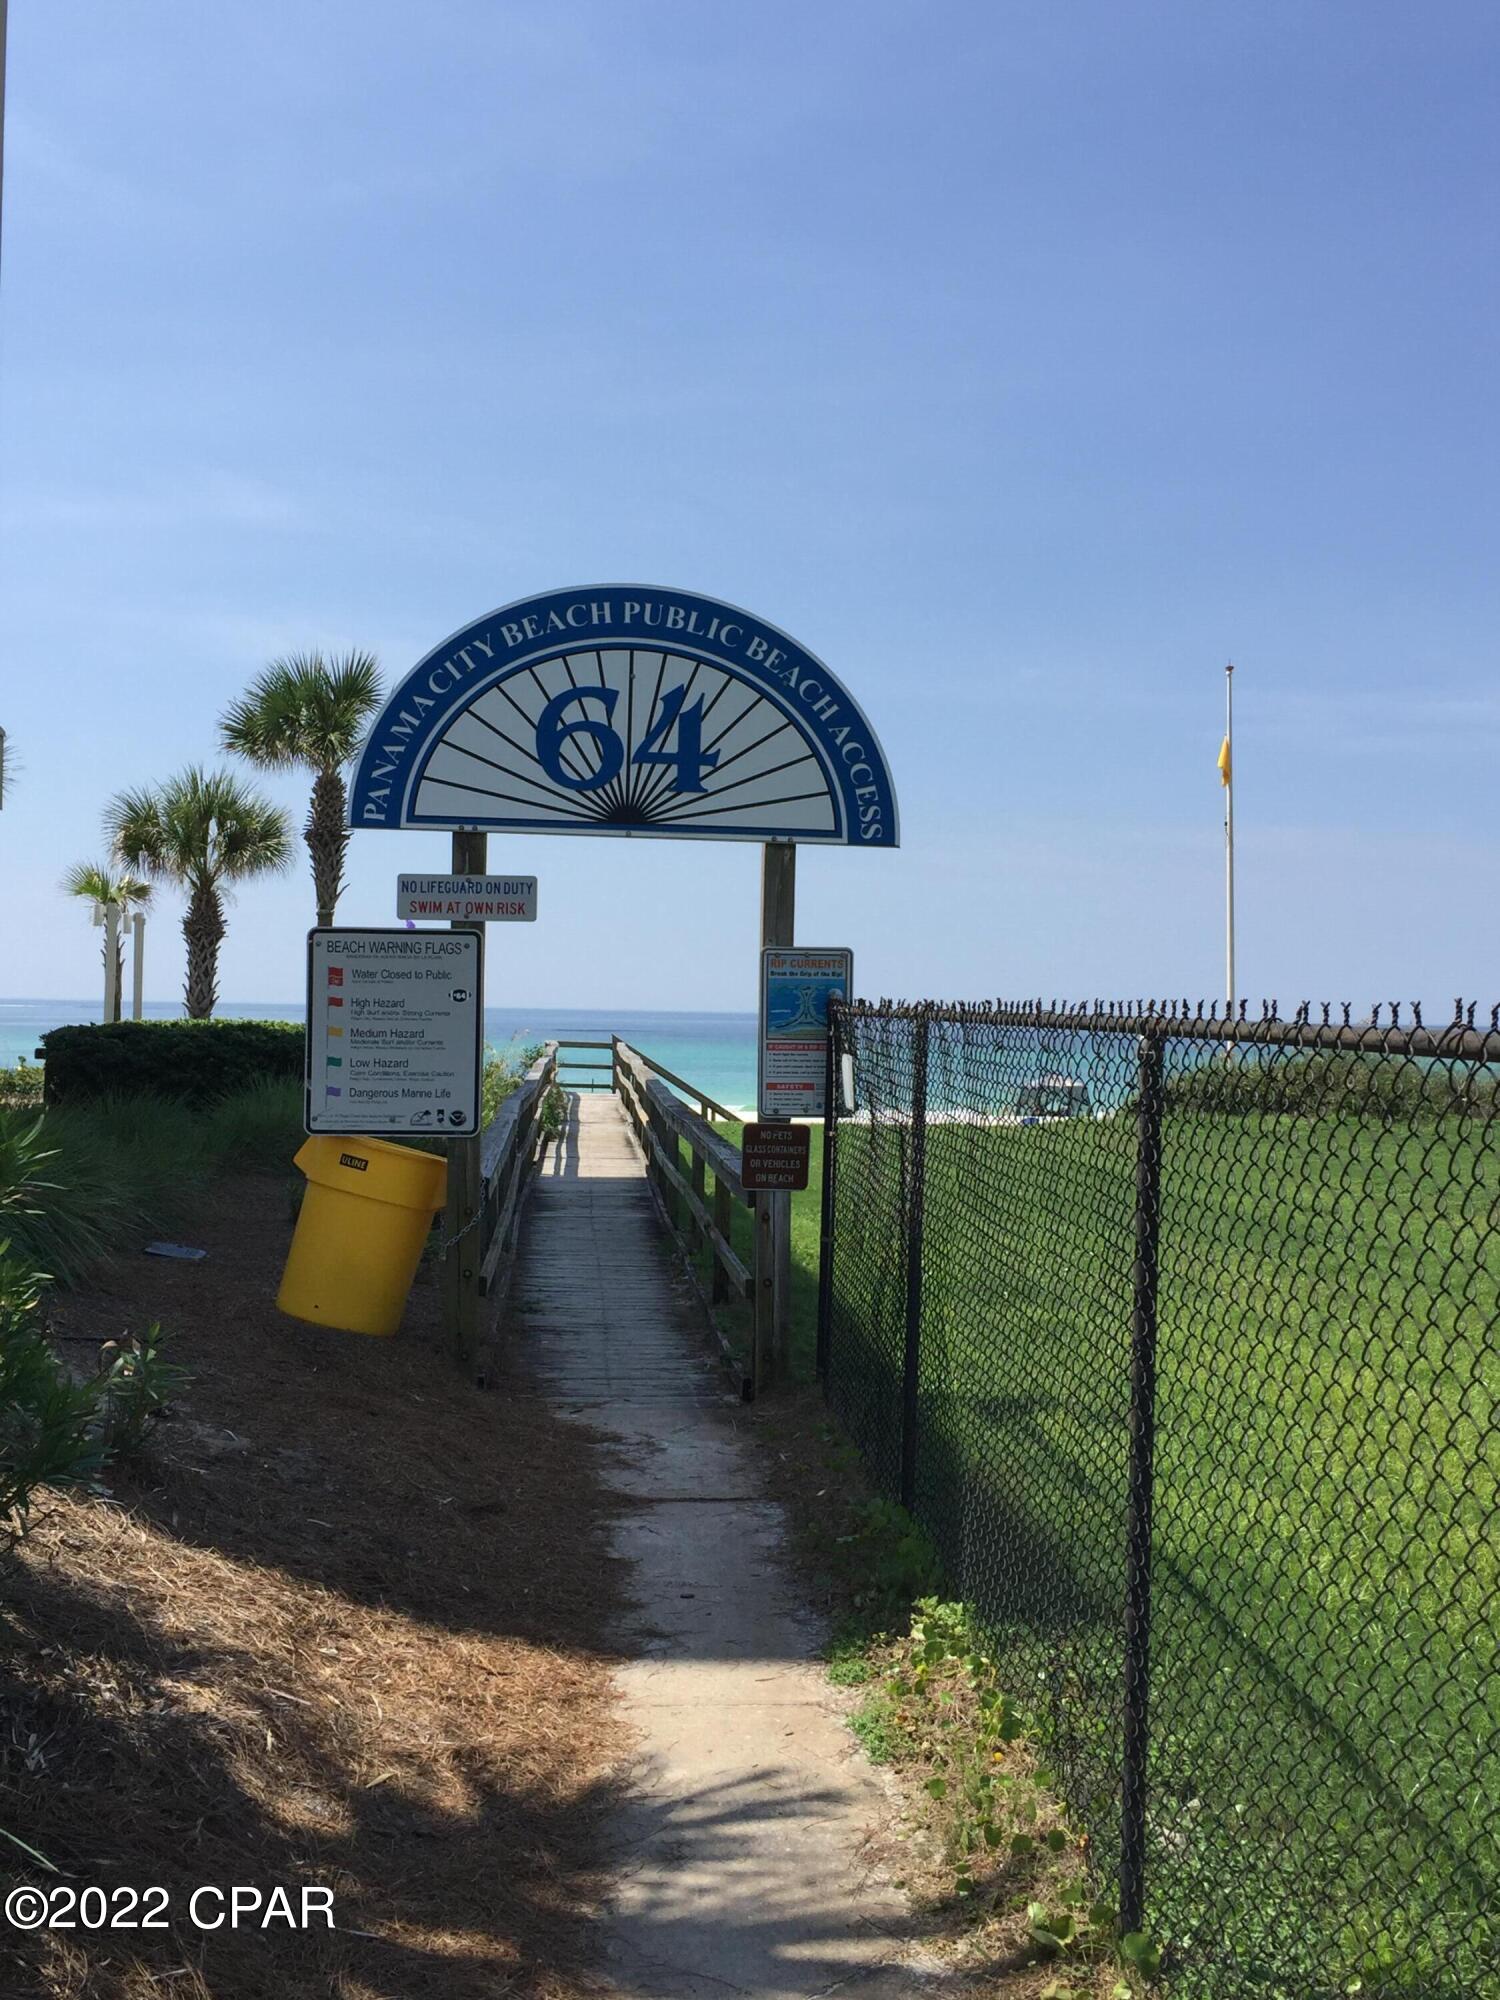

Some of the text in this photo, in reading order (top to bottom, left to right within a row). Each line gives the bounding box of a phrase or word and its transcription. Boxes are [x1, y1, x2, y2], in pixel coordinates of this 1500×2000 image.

[364, 601, 884, 841] PANAMA CITY BEACH PUBLIC BEACH ACCESS
[535, 683, 721, 792] 64
[401, 880, 533, 894] NO LIFEGUARD ON DUTY
[410, 900, 526, 914] SWIM AT OWN RISK
[327, 940, 463, 955] BEACH WARNING FLAGS
[790, 959, 845, 969] CURRENTS
[352, 969, 452, 980] Water Closed to Public
[351, 999, 405, 1009] High Hazard
[350, 1028, 425, 1039] Medium Hazard
[350, 1058, 409, 1069] Low Hazard
[349, 1088, 451, 1099] Dangerous Marine Life
[760, 1131, 771, 1139] NO
[341, 1155, 367, 1169] ULINE
[751, 1159, 800, 1168] OR VEHICLES
[755, 1173, 794, 1182] ON BEACH
